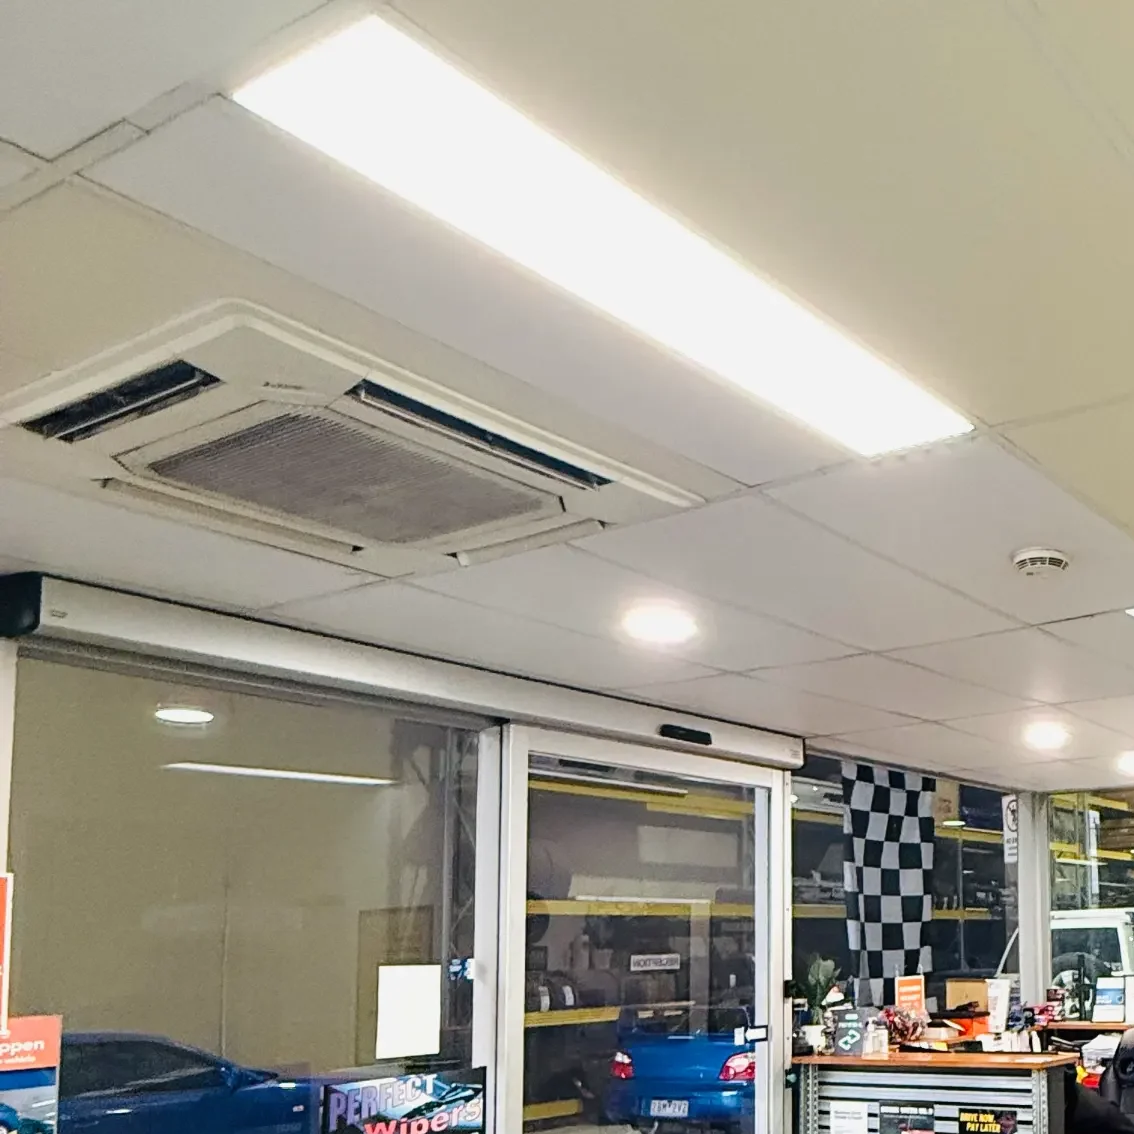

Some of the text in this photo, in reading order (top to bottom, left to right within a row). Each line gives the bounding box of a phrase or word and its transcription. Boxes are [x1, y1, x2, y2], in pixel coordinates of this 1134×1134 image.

[329, 1073, 438, 1132] PERFECT
[966, 1122, 1001, 1133] PAY LATER
